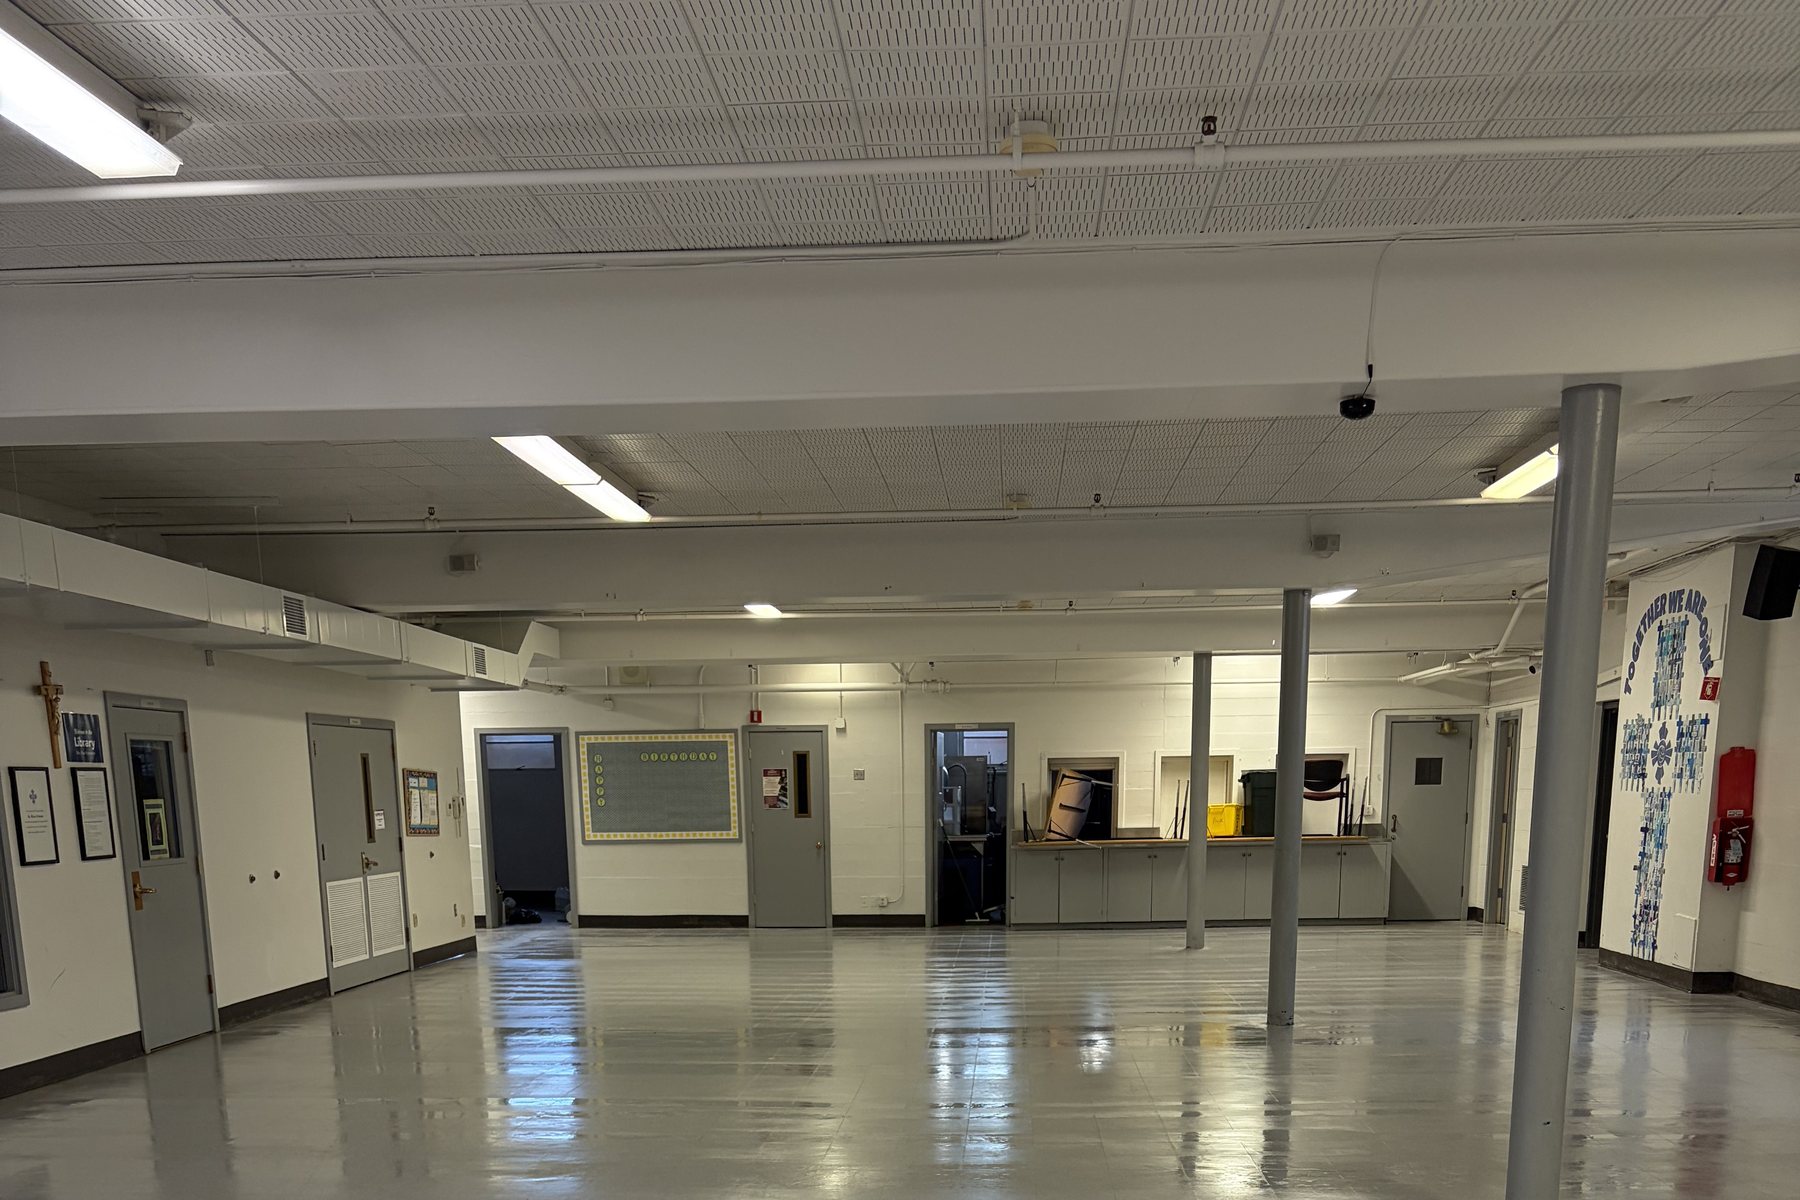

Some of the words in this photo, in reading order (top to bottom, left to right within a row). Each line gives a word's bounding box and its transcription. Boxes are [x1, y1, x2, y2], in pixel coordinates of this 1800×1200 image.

[1624, 593, 1667, 694] TOGETHER
[1669, 589, 1685, 614] WE
[1685, 589, 1707, 622] ARE
[1699, 617, 1713, 676] ONE
[74, 736, 95, 750] Library
[641, 752, 717, 762] BIRTHDAY
[594, 754, 606, 807] HAPPY
